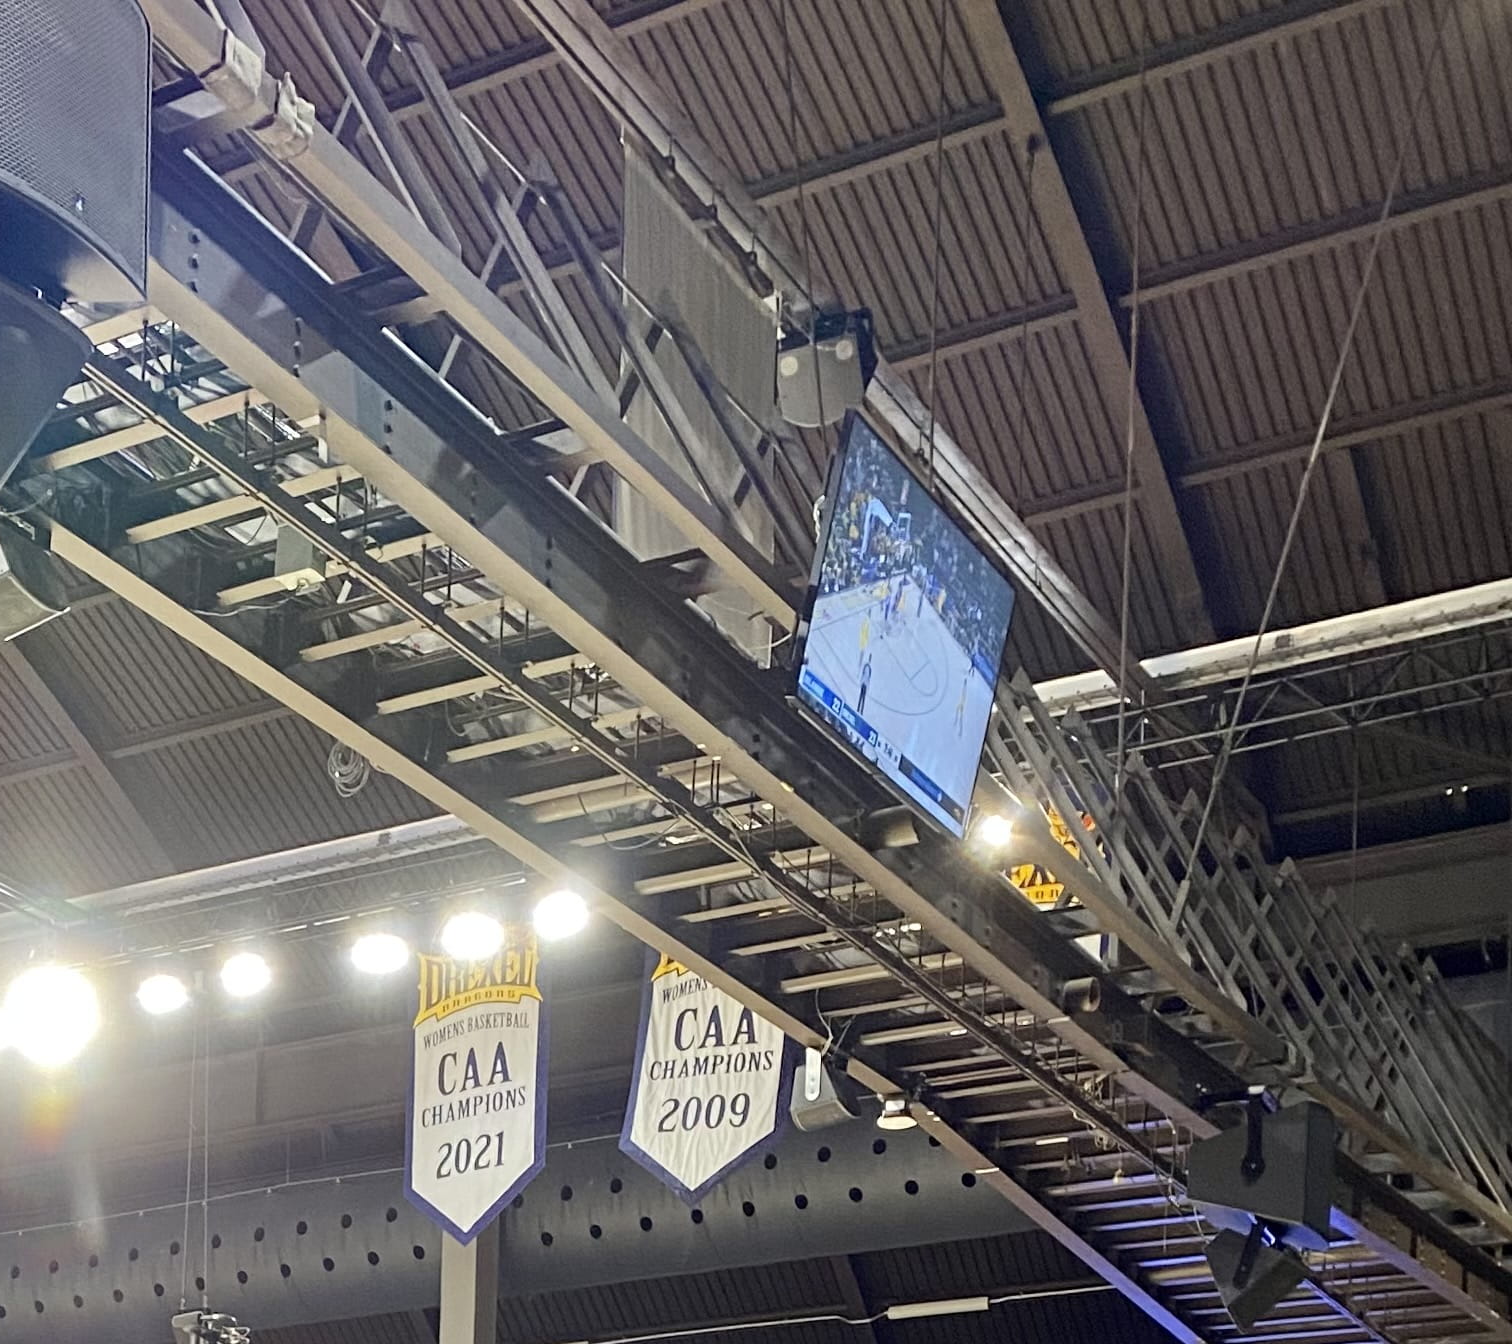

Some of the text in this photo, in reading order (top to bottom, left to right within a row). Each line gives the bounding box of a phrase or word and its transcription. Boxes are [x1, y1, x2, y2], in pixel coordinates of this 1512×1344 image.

[662, 978, 708, 1004] WOMENS
[424, 1012, 530, 1050] WOMENS BASKETBALL
[674, 1004, 758, 1051] CAA
[438, 1040, 512, 1096] CAA
[650, 1050, 774, 1081] CHAMPIONS
[422, 1086, 526, 1128] CHAMPIONS
[658, 1092, 751, 1133] 2009
[436, 1130, 505, 1180] 2021
